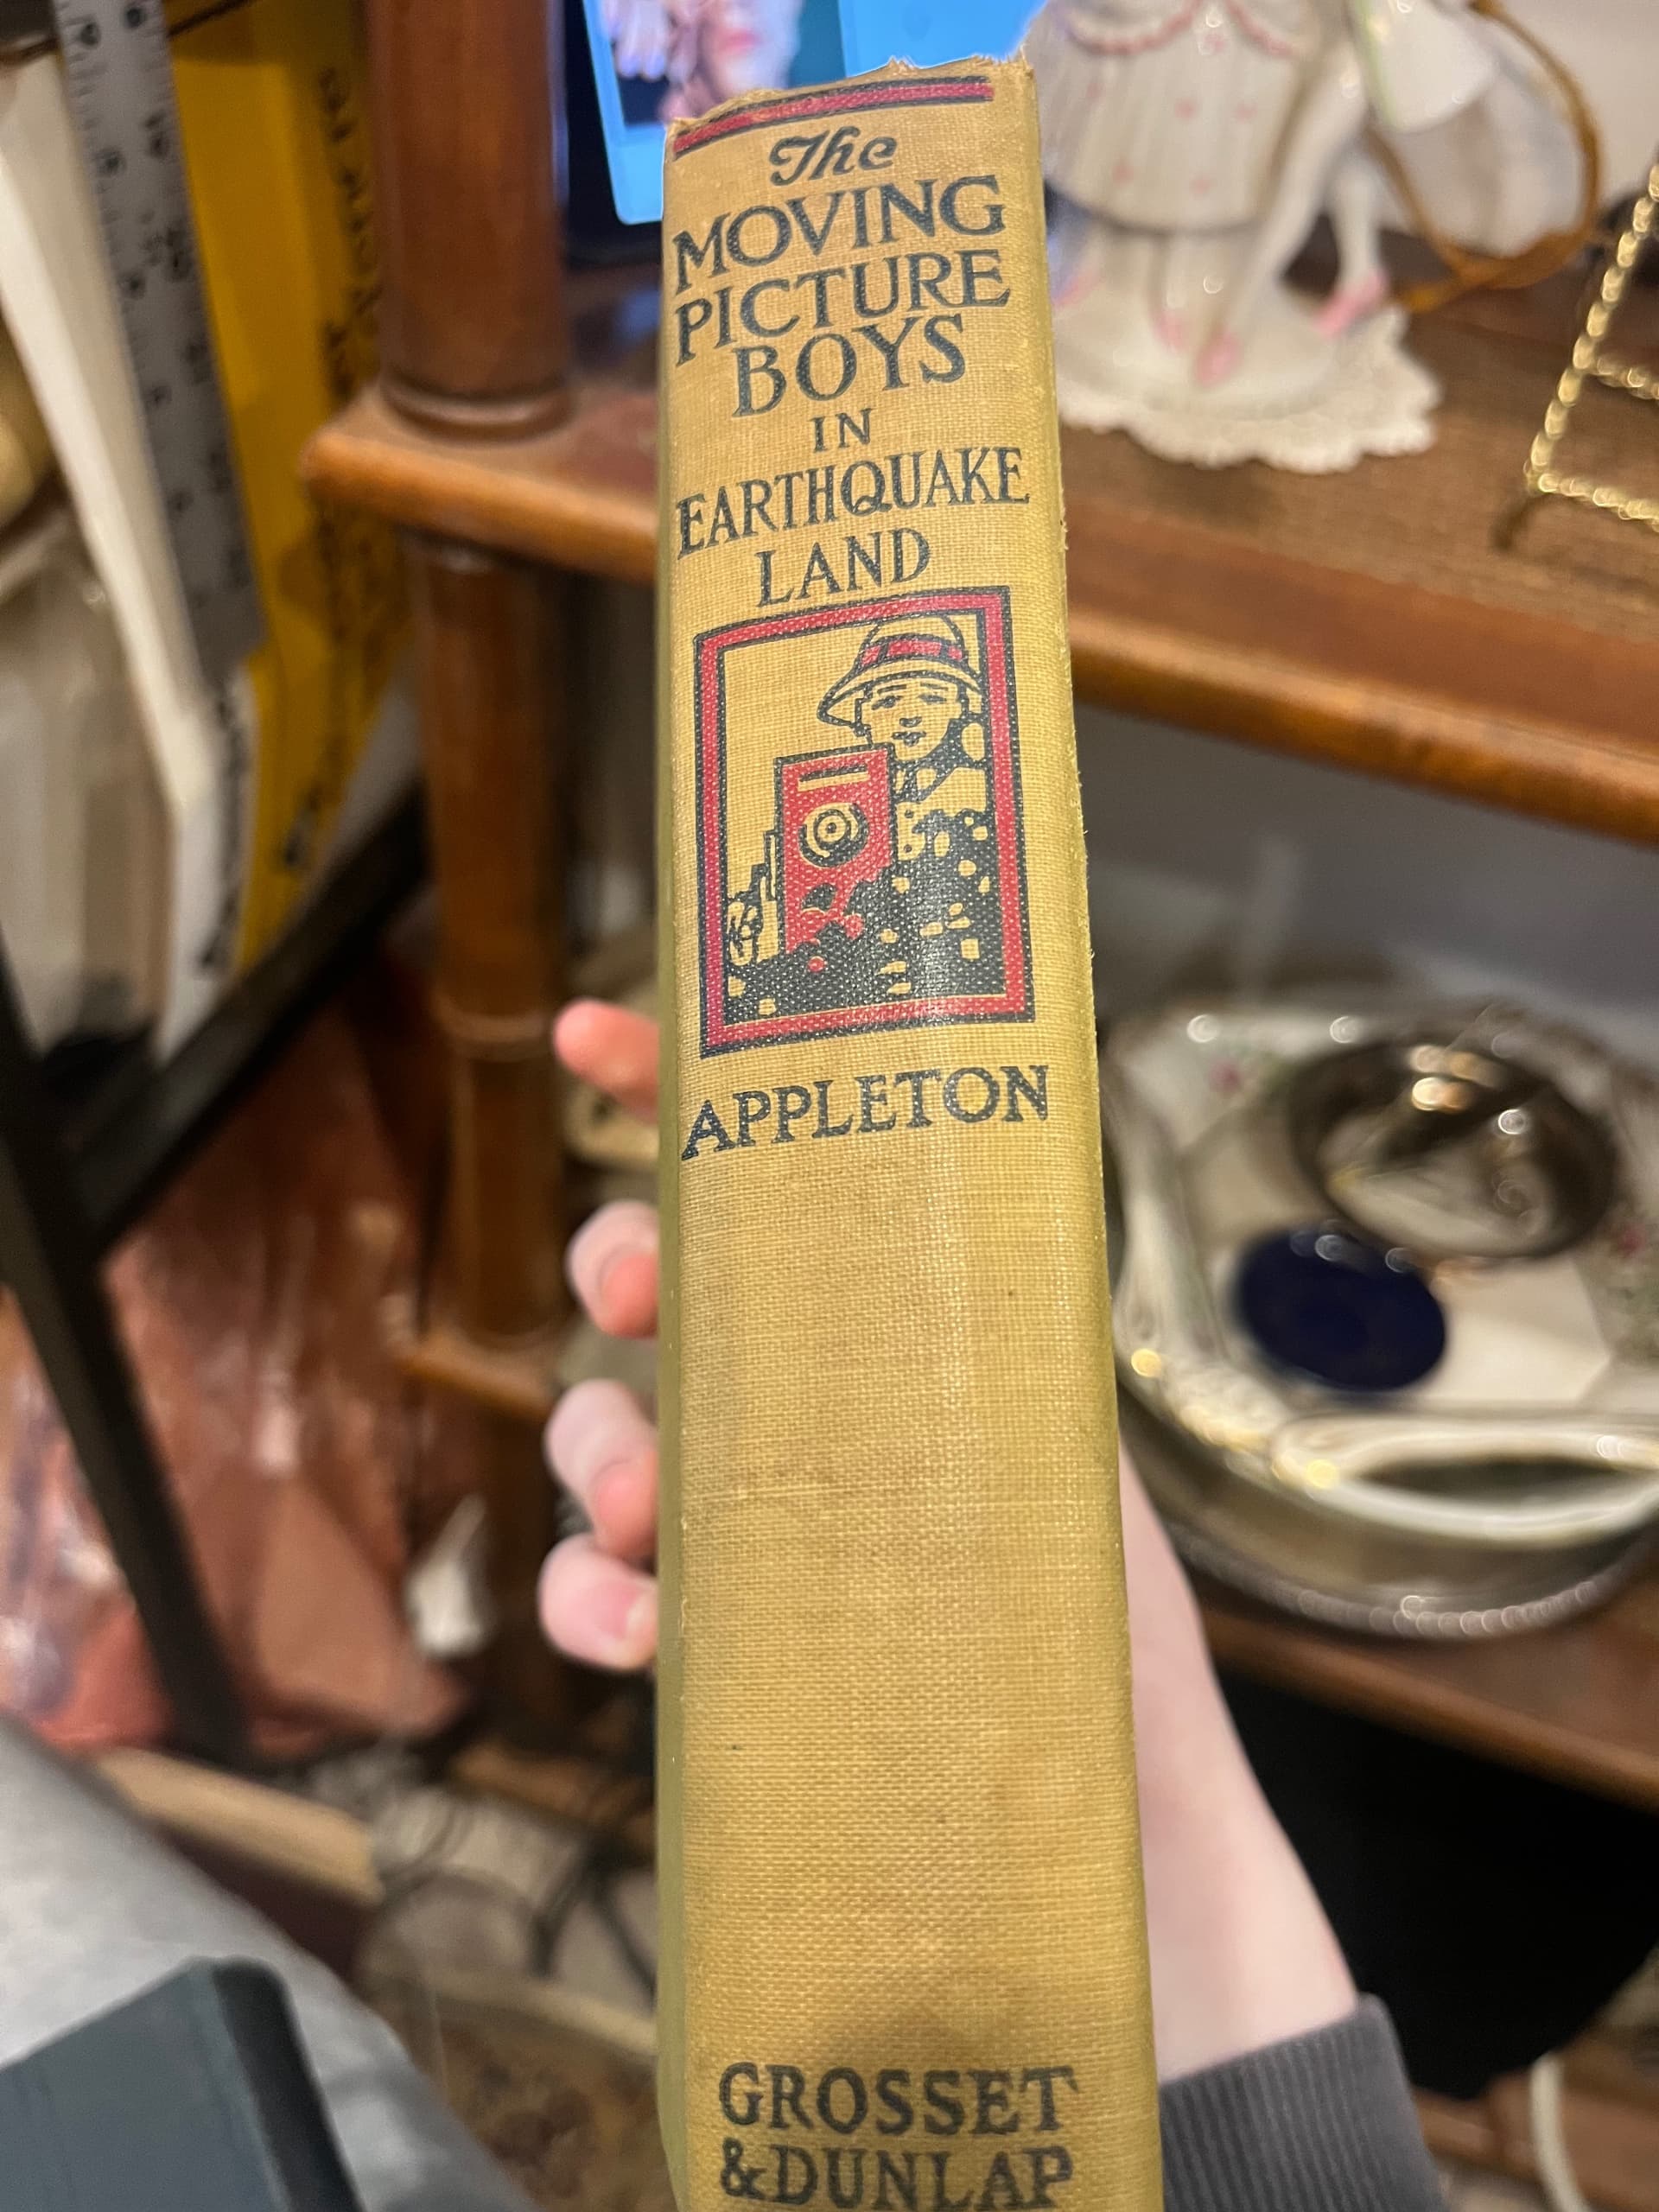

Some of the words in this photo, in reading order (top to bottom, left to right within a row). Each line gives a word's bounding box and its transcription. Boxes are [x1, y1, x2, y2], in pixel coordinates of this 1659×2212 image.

[768, 125, 896, 187] The
[672, 174, 1005, 296] MOVING
[675, 248, 1010, 366] PICTURE
[731, 313, 965, 417] BOYS
[812, 407, 872, 451] IN
[675, 446, 1029, 560] EARTHQUAKE
[755, 526, 930, 607] LAND
[681, 1065, 1049, 1160] APPLETON
[719, 2063, 1079, 2136] GROSSET
